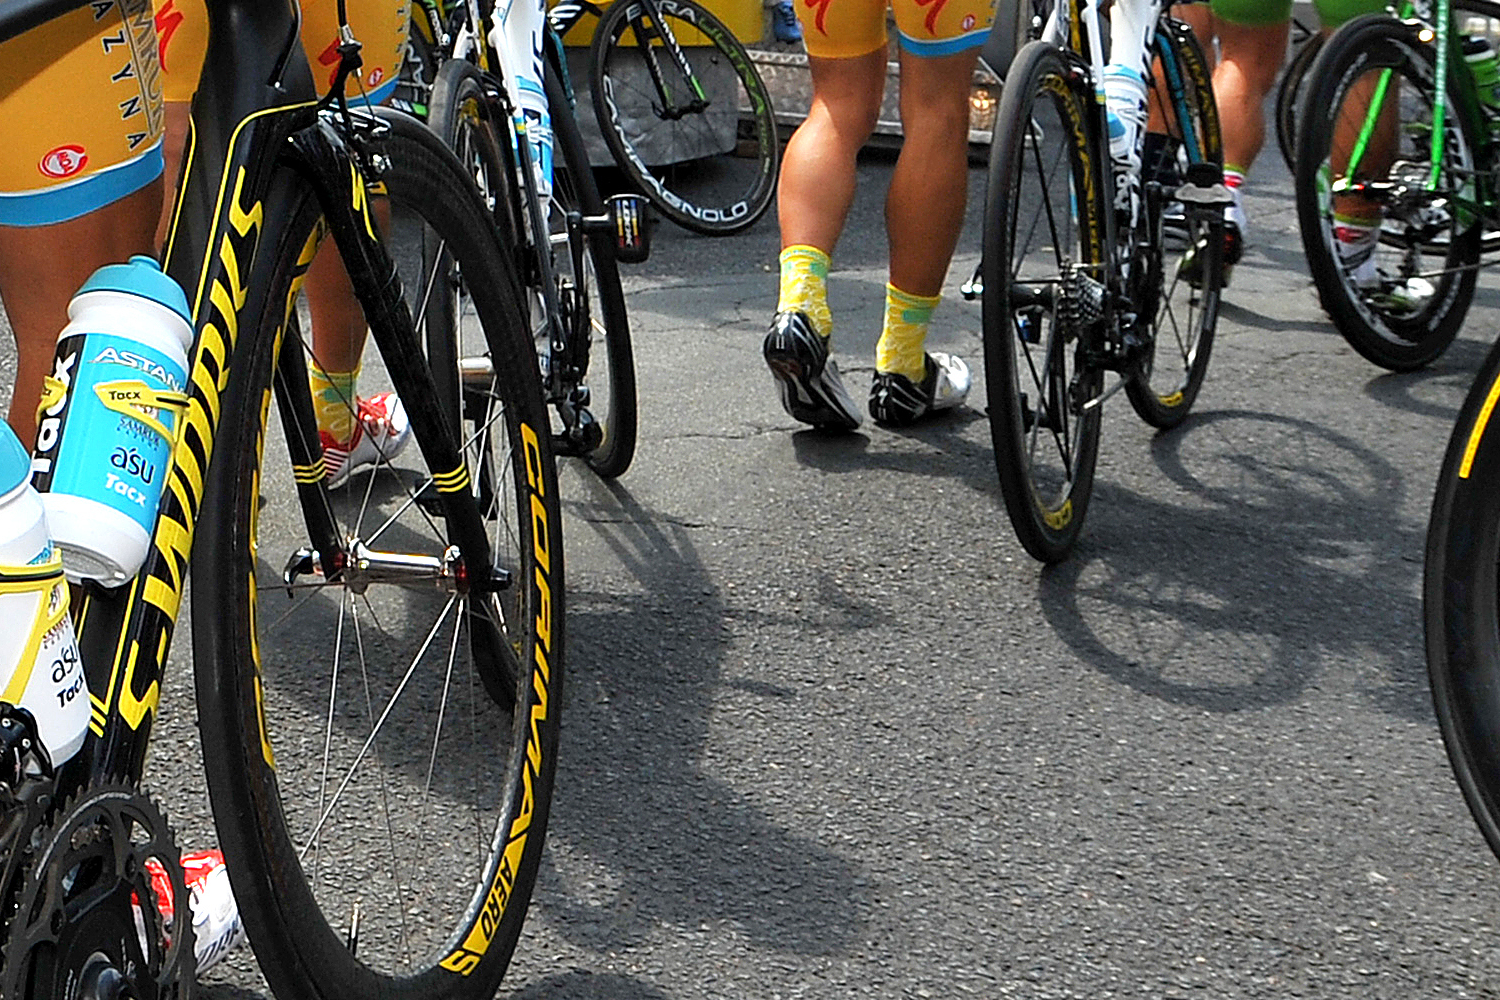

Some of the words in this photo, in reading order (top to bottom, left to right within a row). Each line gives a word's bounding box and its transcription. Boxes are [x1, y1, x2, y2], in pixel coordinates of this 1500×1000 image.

[108, 390, 142, 400] Tacx
[104, 472, 146, 508] Tacx
[118, 165, 263, 730] S-WORKS
[503, 422, 552, 840] CORIMA
[479, 854, 513, 942] AERO
